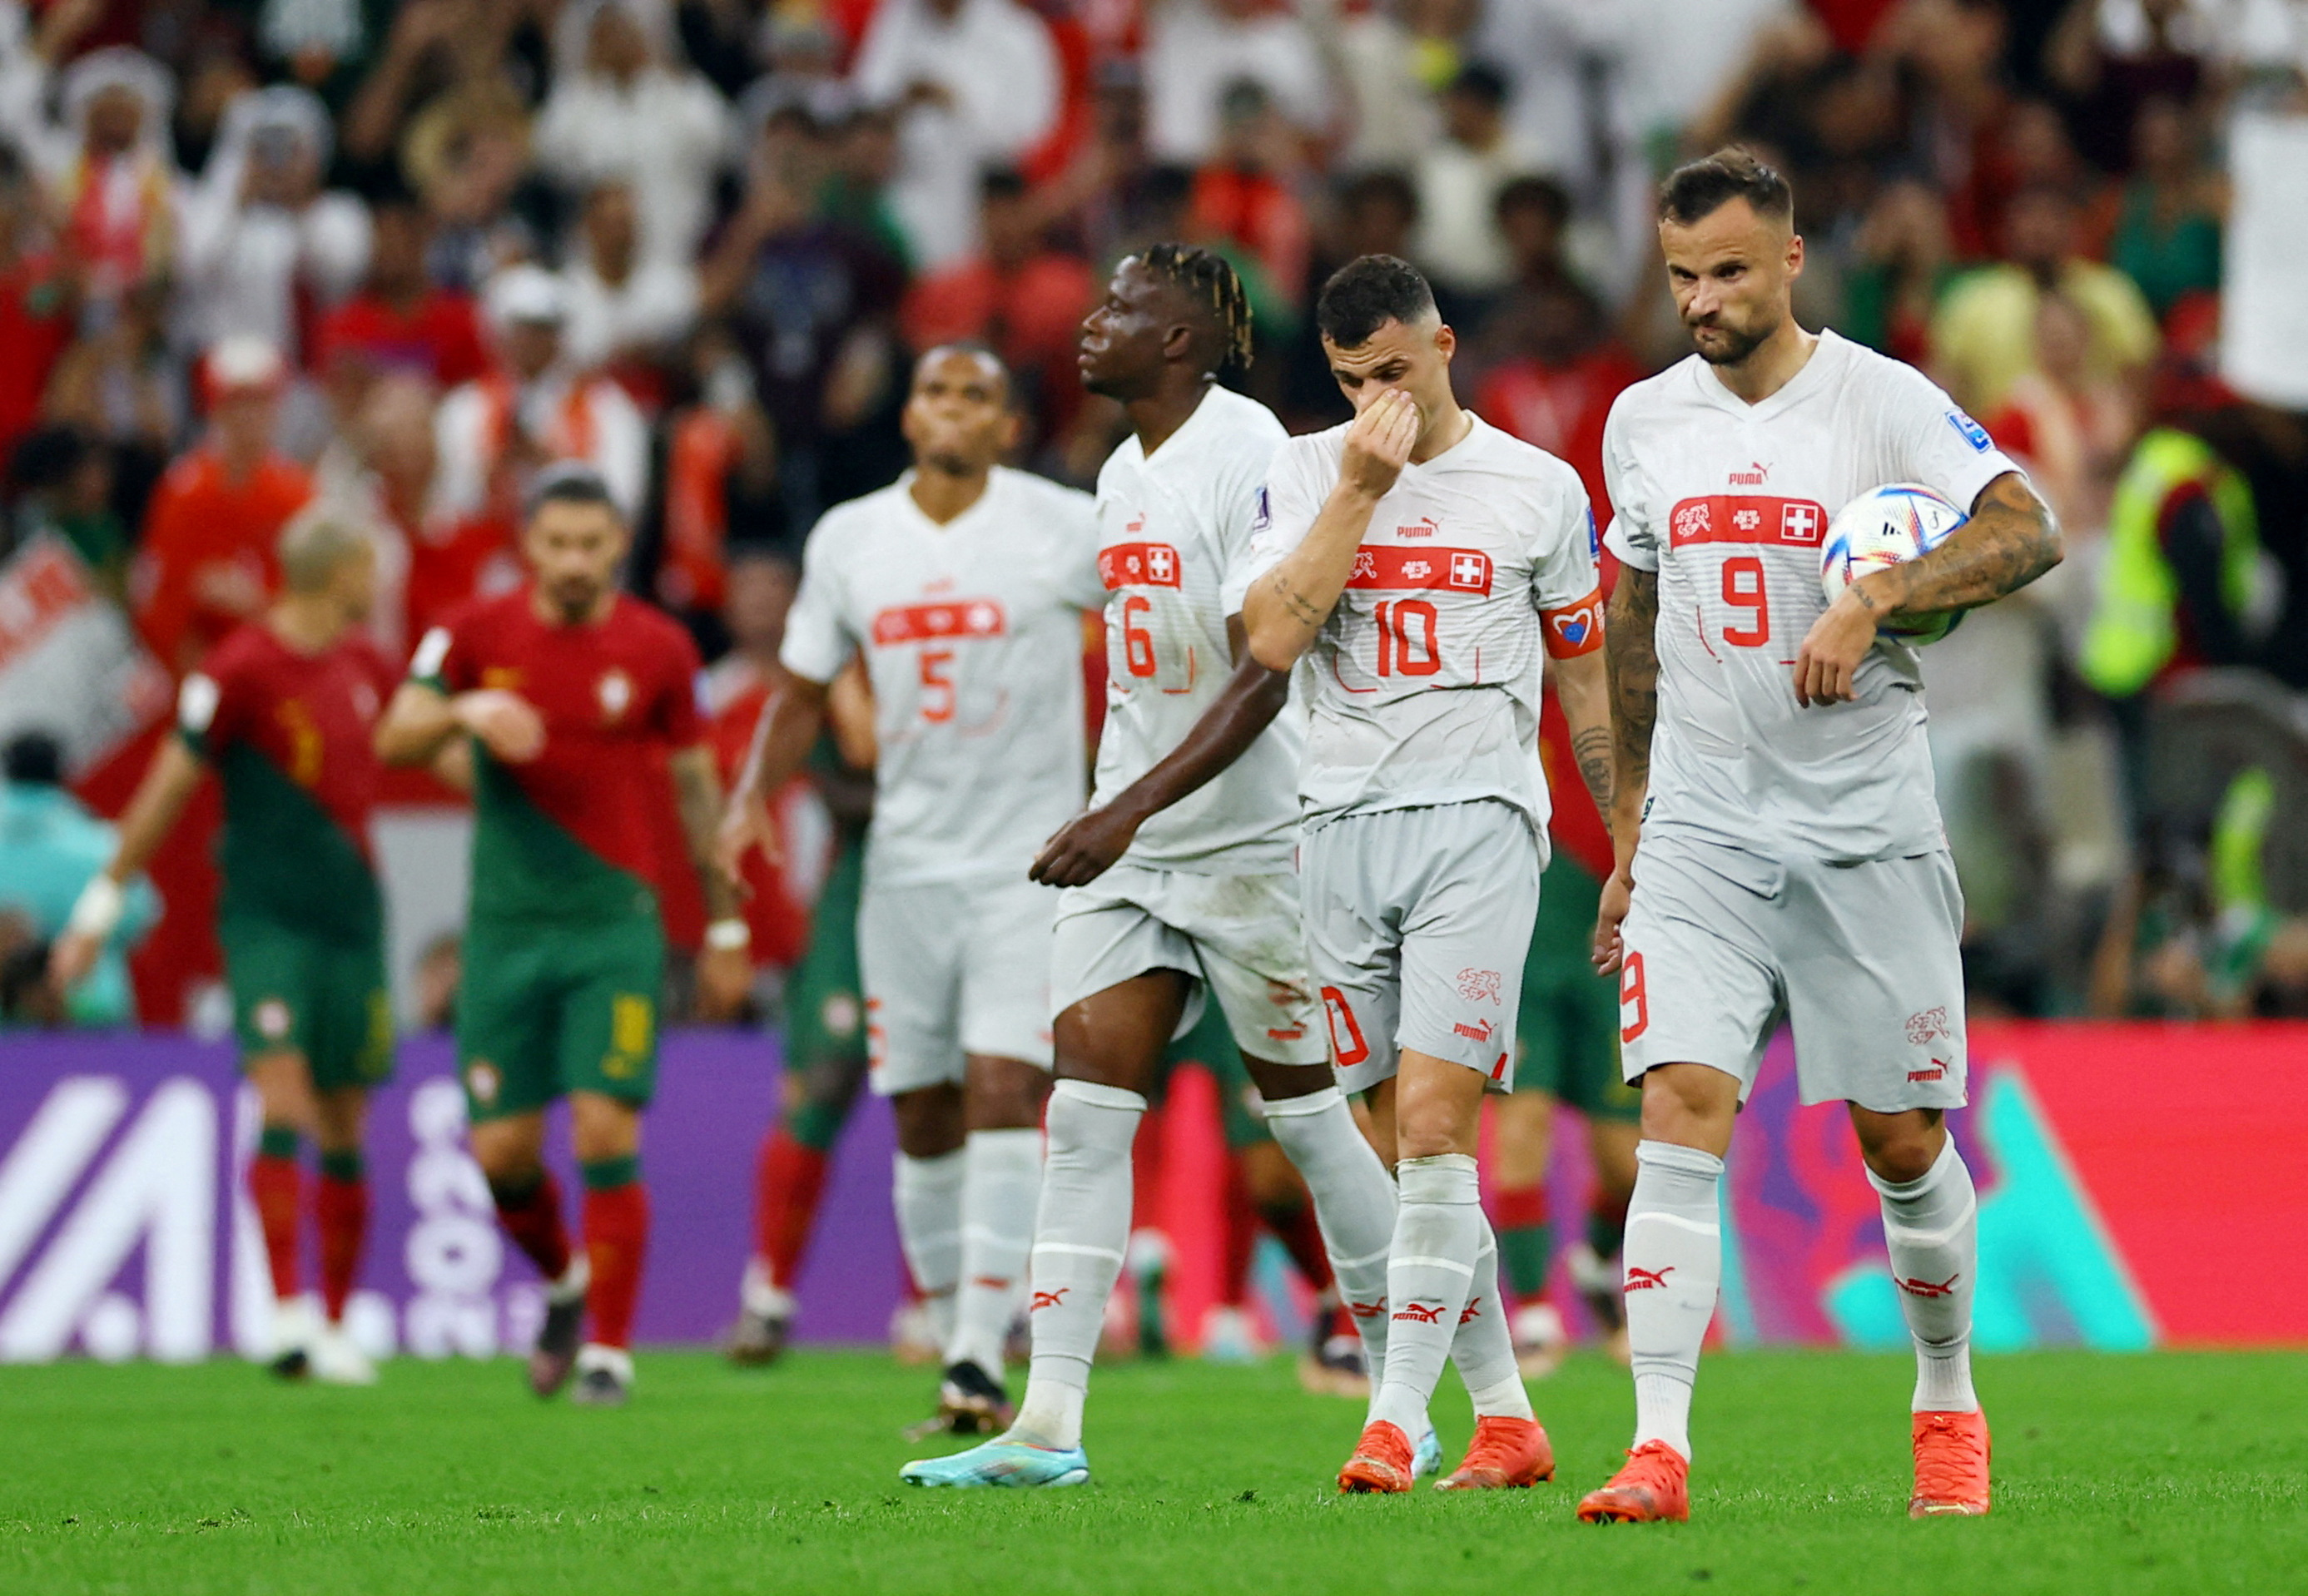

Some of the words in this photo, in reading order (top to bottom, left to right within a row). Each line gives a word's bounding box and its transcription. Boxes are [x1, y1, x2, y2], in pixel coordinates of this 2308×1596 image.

[1729, 473, 1763, 485] PUMA
[1397, 526, 1433, 538] PUMA
[1124, 596, 1157, 677] 6
[1375, 599, 1441, 677] 10
[1722, 557, 1769, 647] 9
[920, 650, 956, 723] 5
[1454, 1023, 1488, 1043] PUMA
[1621, 951, 1648, 1043] 9
[1908, 1069, 1942, 1083] PUMA
